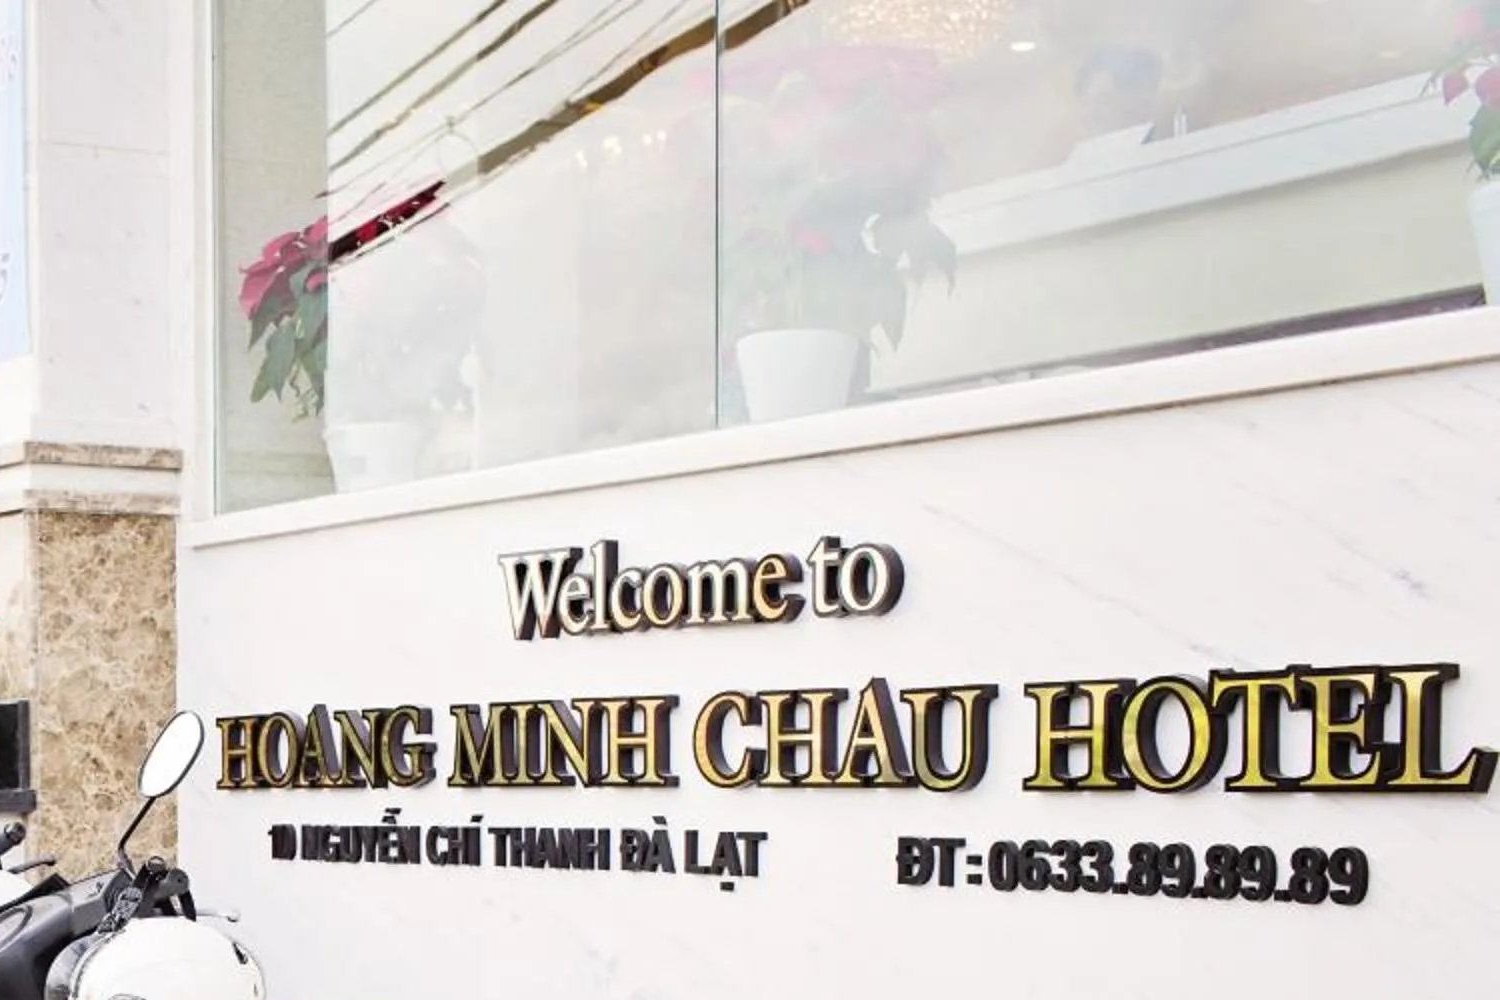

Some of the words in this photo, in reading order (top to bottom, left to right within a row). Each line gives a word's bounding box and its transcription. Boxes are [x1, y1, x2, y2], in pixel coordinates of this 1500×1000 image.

[498, 539, 805, 640] Welcome
[806, 535, 905, 618] to
[215, 703, 438, 790] HOANG
[448, 695, 680, 789] MINH
[693, 677, 999, 792] CHAU
[1022, 662, 1499, 794] HOTEL
[426, 814, 484, 867] CHÍ
[488, 827, 611, 872] THANH
[619, 815, 676, 874] ĐÀ
[684, 829, 768, 892] LẠT
